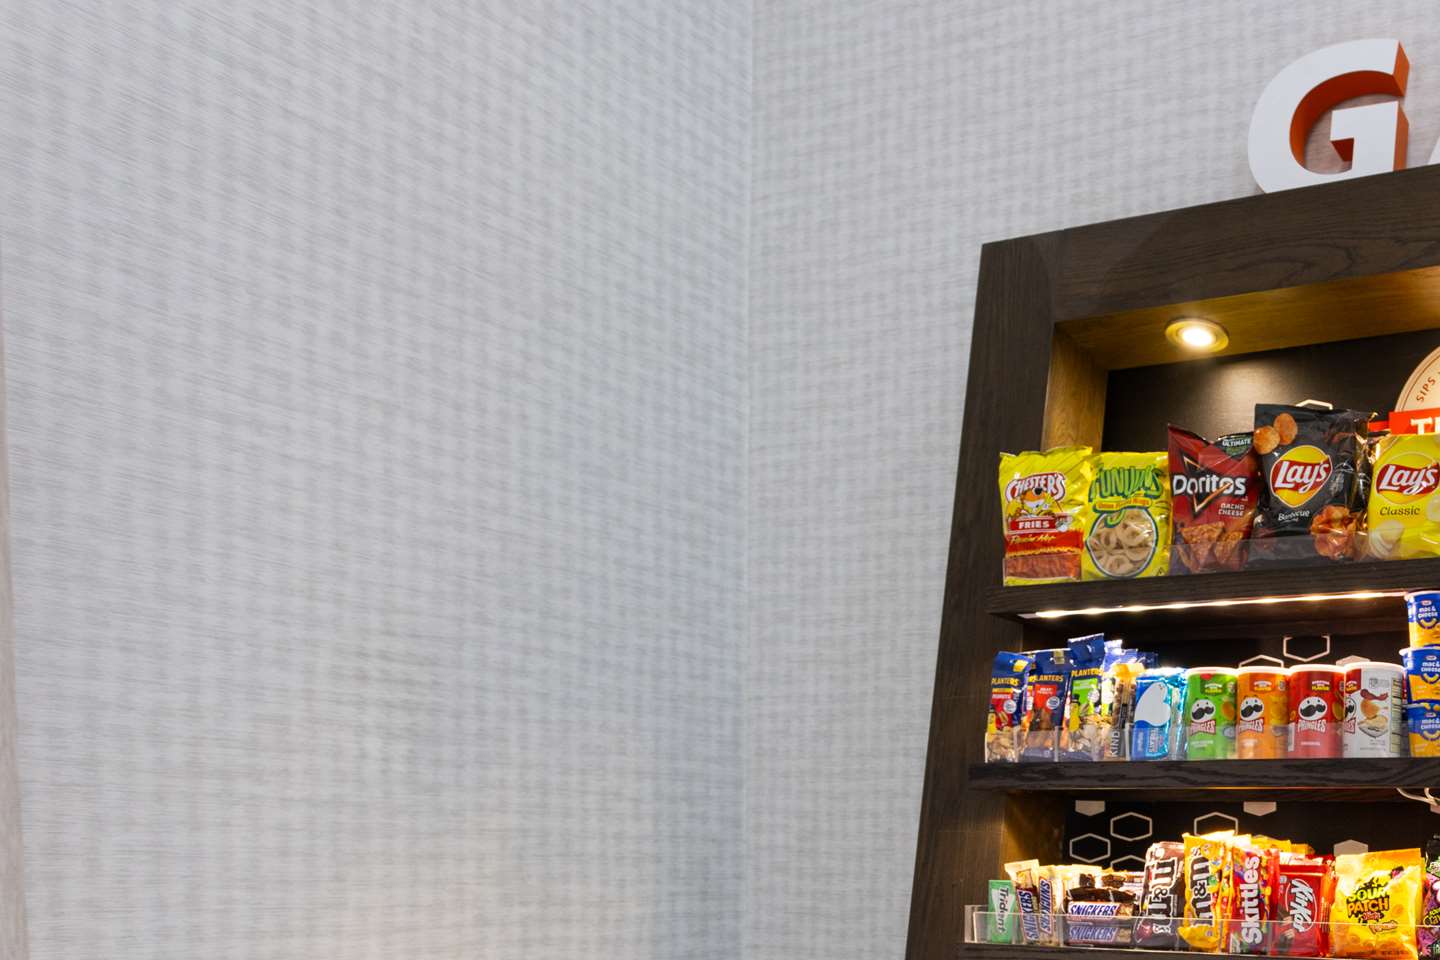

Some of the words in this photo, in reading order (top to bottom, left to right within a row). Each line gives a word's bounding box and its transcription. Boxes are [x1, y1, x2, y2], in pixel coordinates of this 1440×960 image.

[1415, 376, 1437, 403] SIPS
[1005, 472, 1066, 502] CHESTER'S
[1172, 474, 1247, 496] Doritos
[1274, 461, 1330, 495] Lay's
[1379, 462, 1440, 495] Lay's
[1218, 509, 1244, 517] CHEESE
[1379, 505, 1421, 517] Classic
[1018, 521, 1050, 530] FRIES
[1109, 729, 1121, 758] KIND
[1240, 855, 1263, 945] Skittles
[1349, 887, 1388, 902] SOUR
[996, 886, 1010, 935] Trident
[1069, 903, 1119, 917] SNICKERS
[1347, 896, 1391, 916] PATCH
[1068, 926, 1117, 941] SNICKERS
